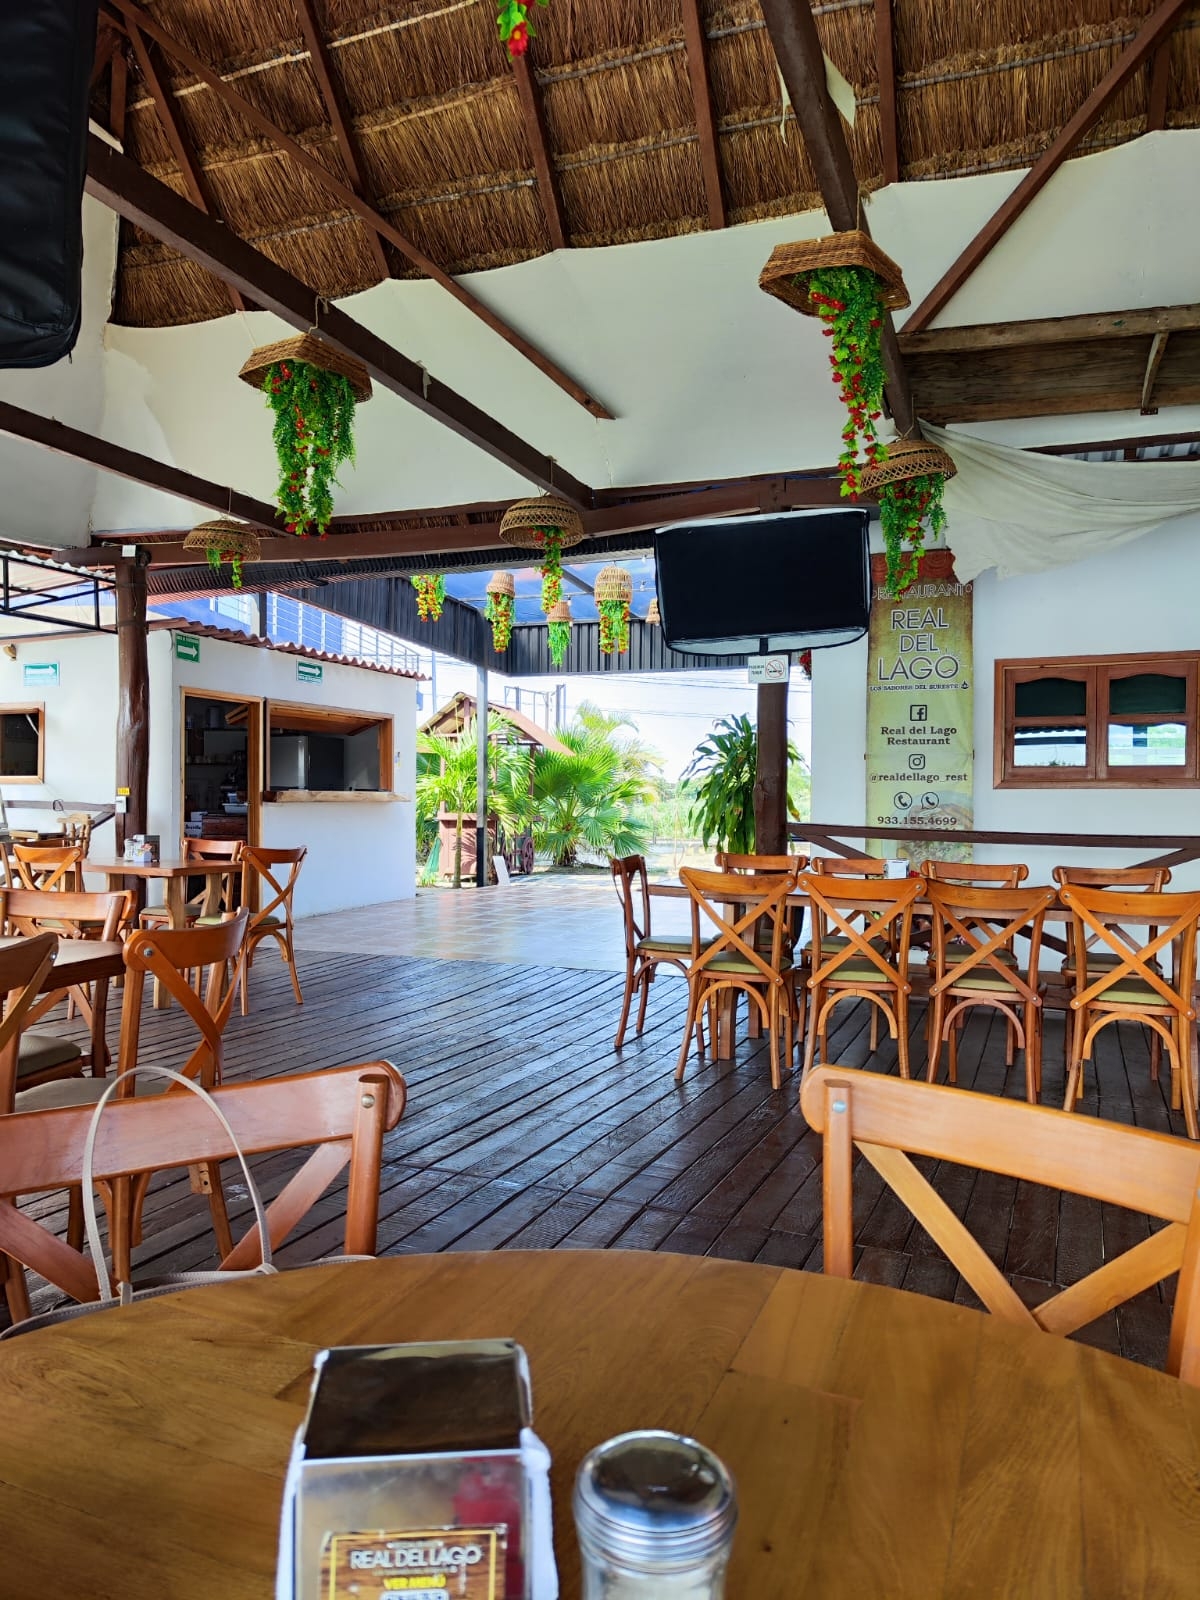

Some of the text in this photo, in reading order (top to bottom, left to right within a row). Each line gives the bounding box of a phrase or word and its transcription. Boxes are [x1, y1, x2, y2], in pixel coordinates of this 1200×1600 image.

[878, 582, 964, 600] REAURANT
[891, 607, 949, 630] REAL
[900, 633, 939, 653] DEL
[878, 654, 960, 681] LAGO
[881, 726, 957, 737] Real del Lago
[887, 736, 951, 746] Restaurant
[870, 772, 968, 784] @realdellago_rest
[877, 816, 957, 826] 933.155.4699
[350, 1545, 483, 1570] REAL DEL LAGO
